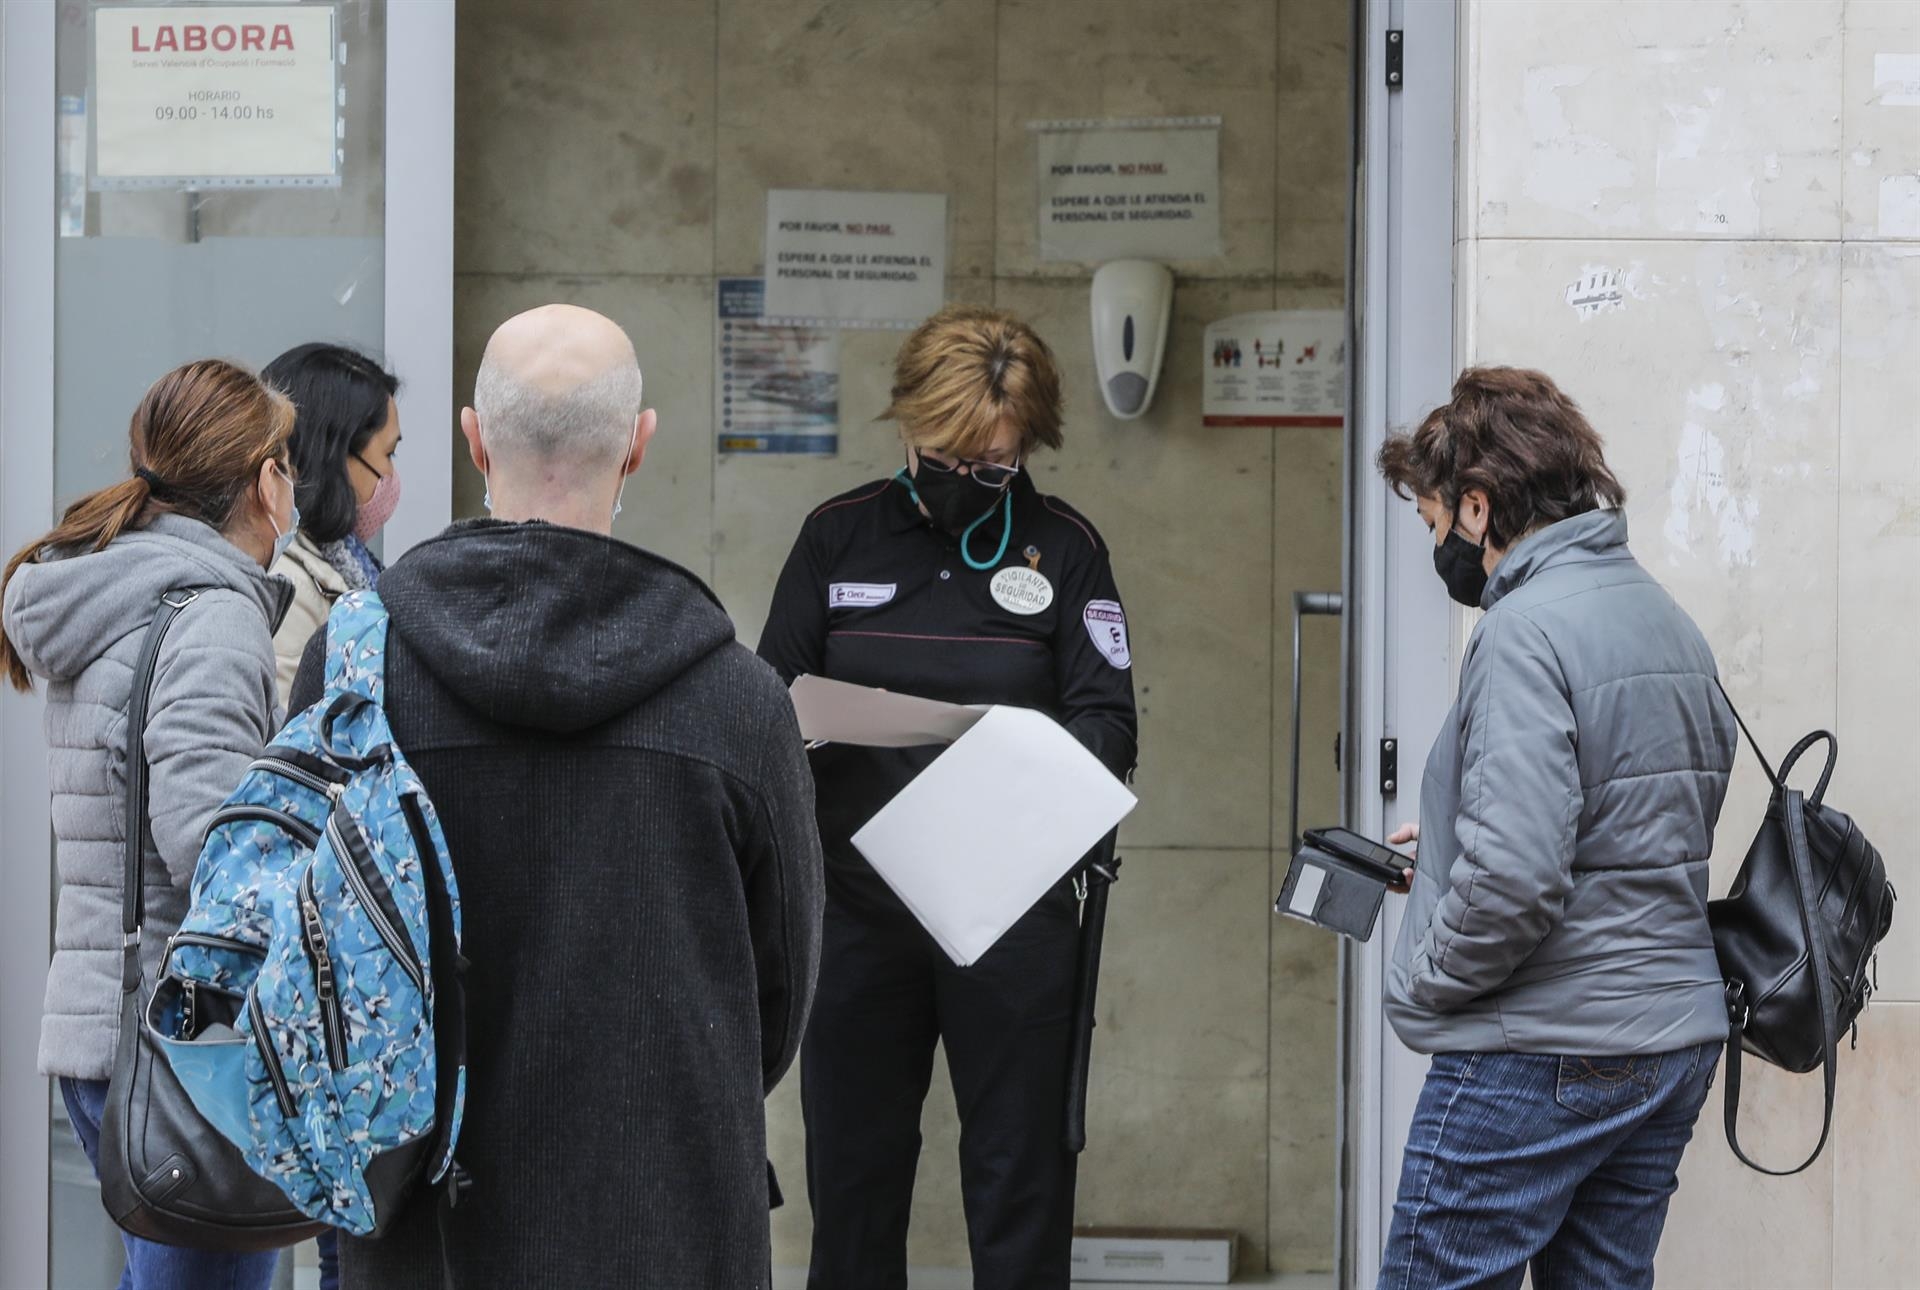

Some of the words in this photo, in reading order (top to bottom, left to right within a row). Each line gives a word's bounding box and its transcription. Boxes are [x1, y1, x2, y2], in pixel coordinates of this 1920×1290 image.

[131, 24, 295, 52] LABORA
[188, 91, 241, 102] HORARIO
[155, 106, 197, 120] 09.00
[211, 105, 252, 120] 14.00
[256, 105, 274, 119] hs
[1051, 165, 1074, 176] POR
[1118, 163, 1135, 175] NO
[1051, 195, 1090, 207] ESPERE
[1093, 196, 1101, 206] A
[1104, 194, 1127, 206] QUE
[1129, 194, 1142, 205] LE
[1144, 192, 1192, 204] ATIENDA
[1194, 192, 1207, 203] EL
[1051, 211, 1108, 222] PERSONAL
[1111, 210, 1126, 221] DE
[778, 221, 801, 232] POR
[846, 223, 864, 234] NO
[777, 252, 817, 264] ESPERE
[819, 253, 828, 264] A
[830, 253, 853, 265] QUE
[855, 254, 868, 265] LE
[870, 255, 917, 266] ATIENDA
[919, 256, 932, 267] EL
[777, 268, 833, 279] PERSONAL
[836, 269, 851, 280] DE
[1000, 571, 1048, 592] VIGILANTE
[995, 582, 1046, 606] SEGURIDAD
